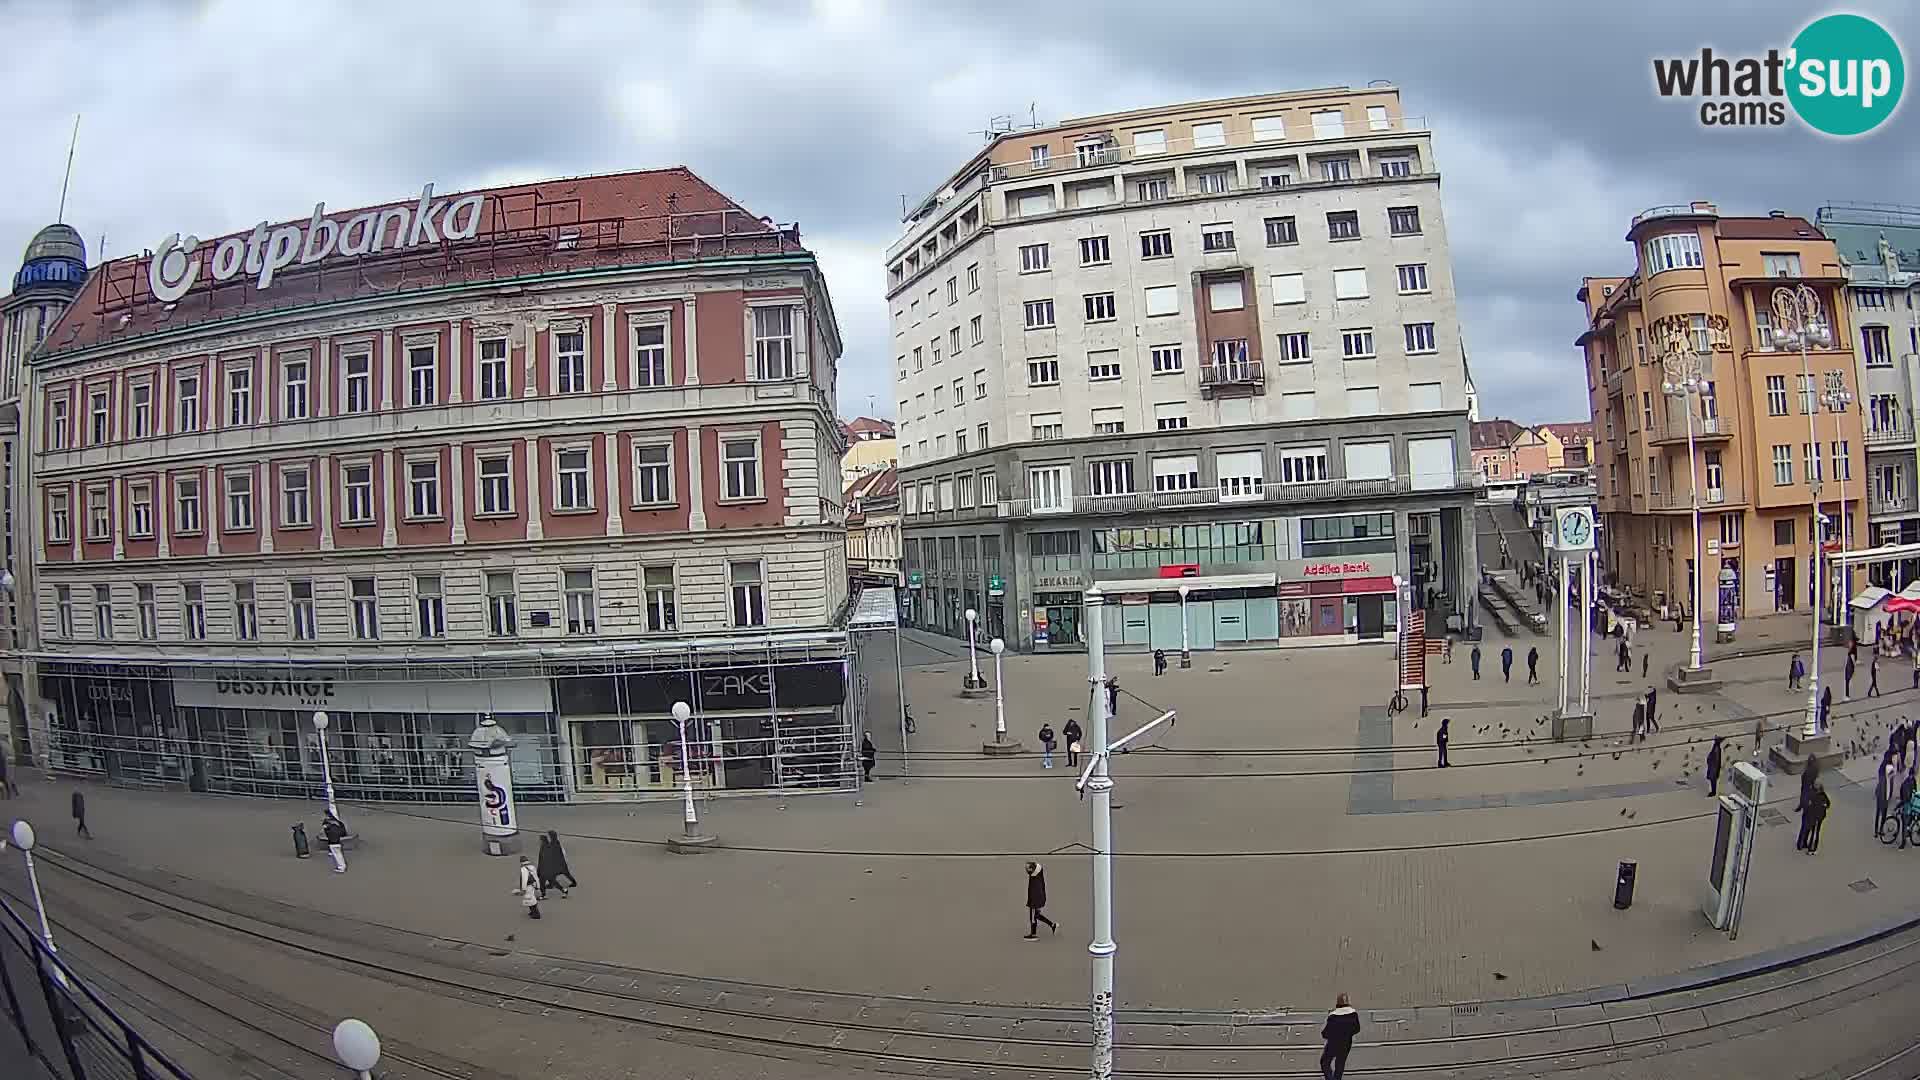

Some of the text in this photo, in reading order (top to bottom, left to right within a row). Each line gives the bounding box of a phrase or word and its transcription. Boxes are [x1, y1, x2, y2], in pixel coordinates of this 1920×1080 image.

[1303, 560, 1371, 577] Addiko Bank
[216, 674, 335, 697] DESSANGE
[703, 673, 774, 696] ZAKS
